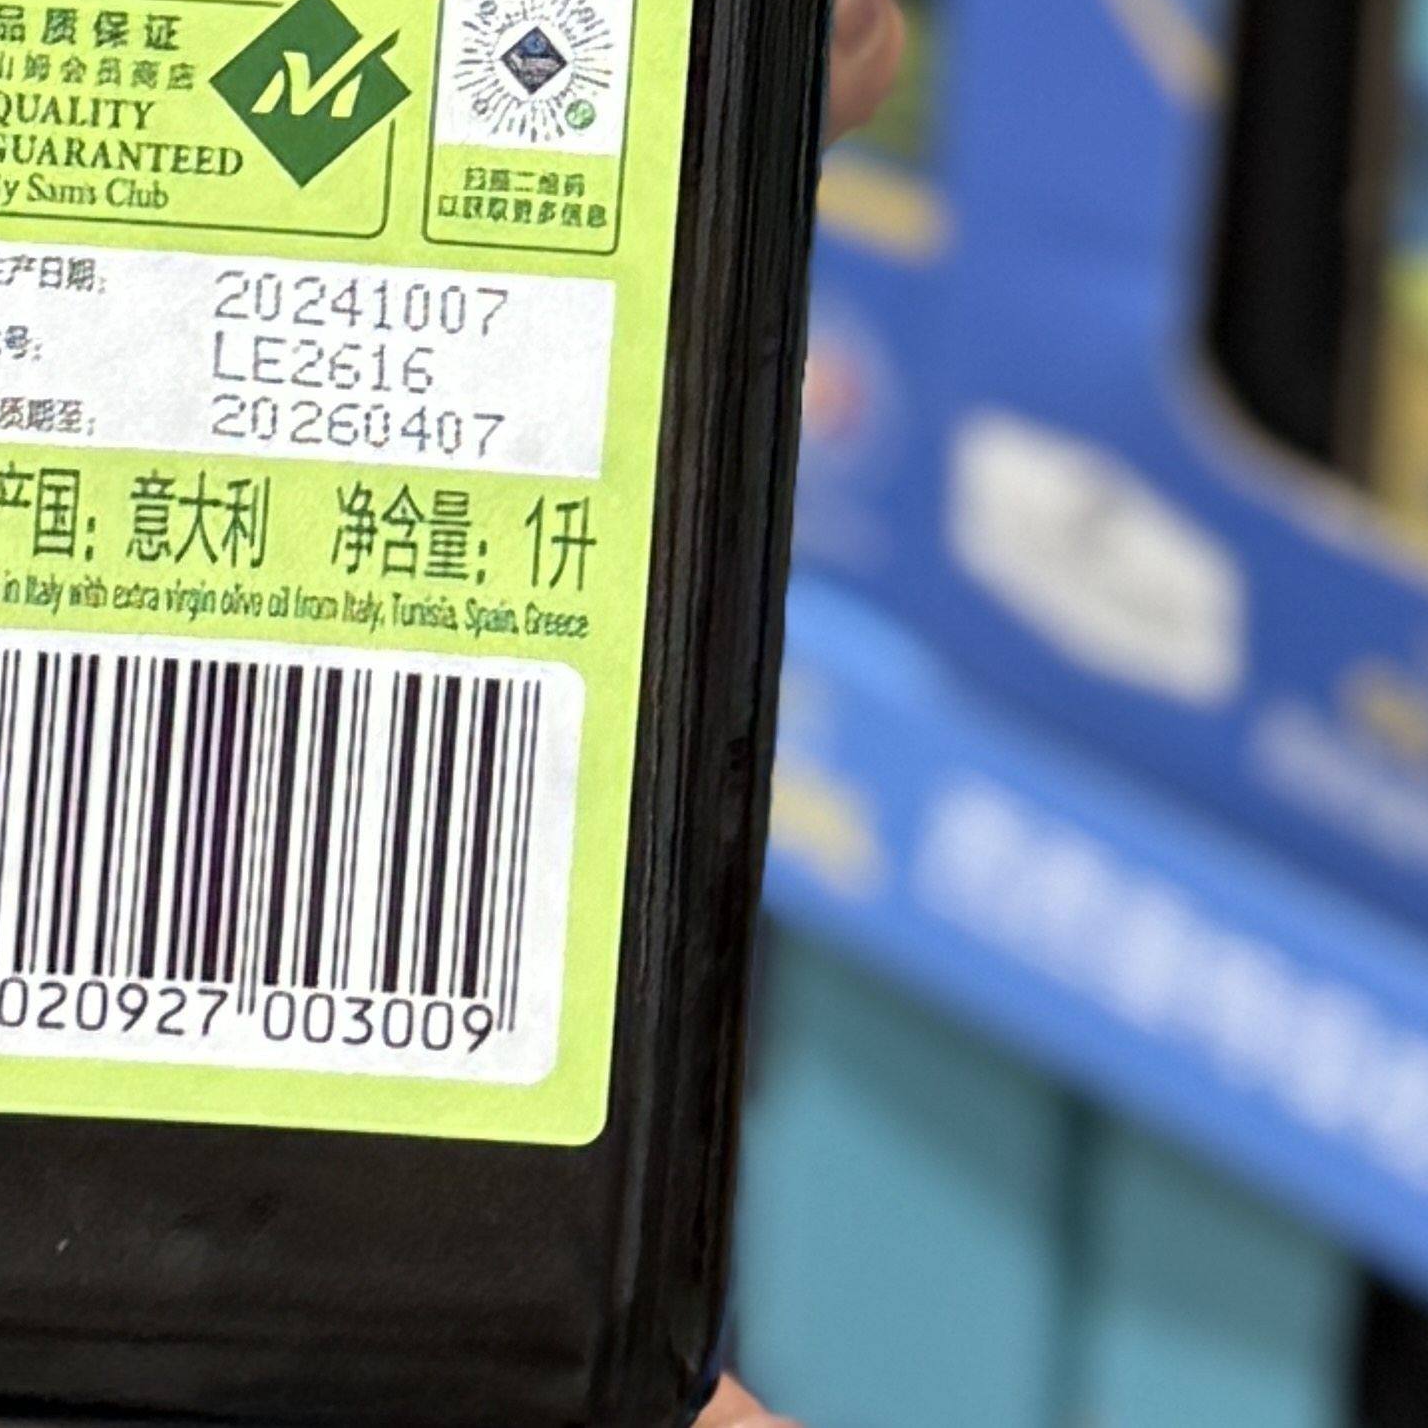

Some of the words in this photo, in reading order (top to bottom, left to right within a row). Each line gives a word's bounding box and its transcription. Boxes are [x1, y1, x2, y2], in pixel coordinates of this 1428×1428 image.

[105, 177, 170, 210] Club
[214, 270, 509, 337] 20241007
[212, 330, 434, 395] LE2616
[211, 393, 506, 457] 20260407
[2, 569, 21, 604] in
[24, 573, 64, 616] Italy
[68, 574, 109, 609] with
[112, 582, 160, 612] extra
[165, 578, 217, 623] virgin
[220, 582, 264, 618] olive
[267, 585, 291, 618] oil
[293, 585, 339, 621] from
[524, 601, 589, 639] Greece
[263, 990, 494, 1053] 003009
